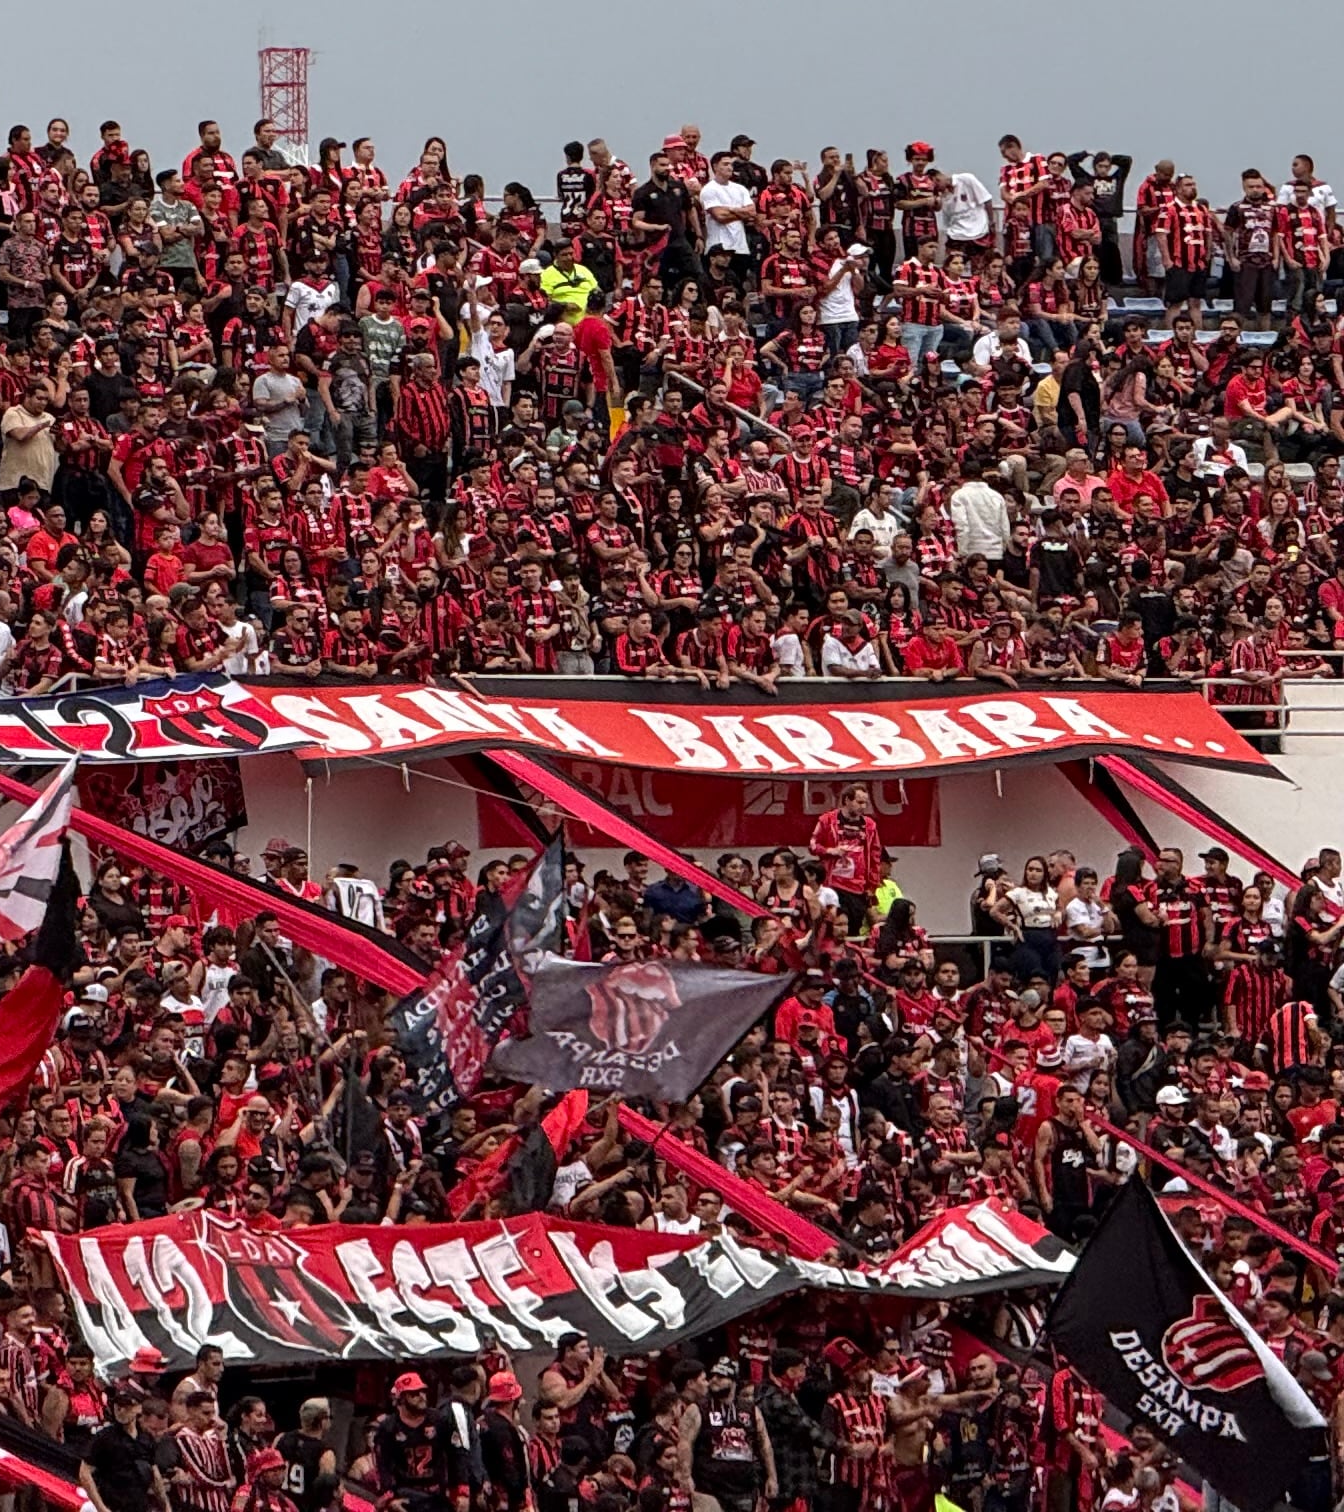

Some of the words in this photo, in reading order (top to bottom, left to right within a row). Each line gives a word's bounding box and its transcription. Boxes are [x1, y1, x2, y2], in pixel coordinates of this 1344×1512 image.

[153, 695, 213, 714] LDA
[272, 687, 624, 754] SANTA
[802, 778, 905, 816] BC
[222, 1235, 293, 1265] LDA
[1107, 1328, 1247, 1443] DESAMPA
